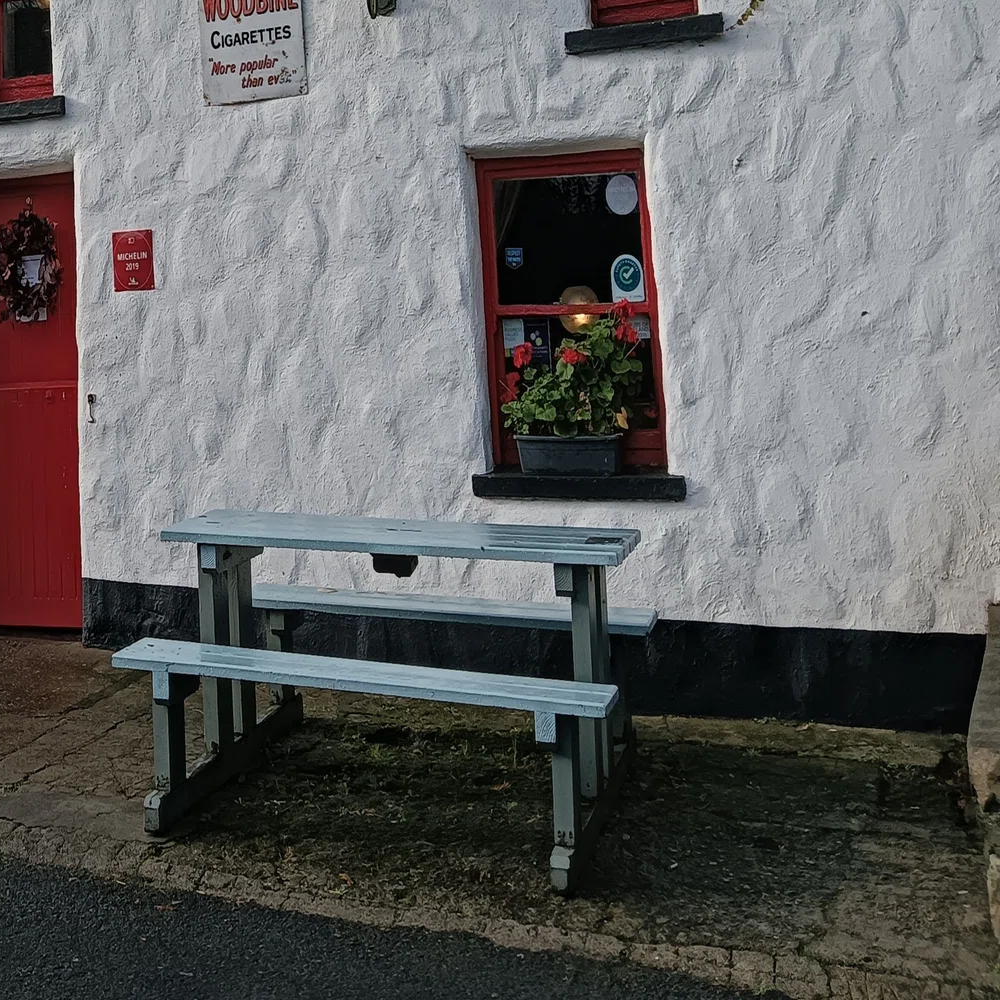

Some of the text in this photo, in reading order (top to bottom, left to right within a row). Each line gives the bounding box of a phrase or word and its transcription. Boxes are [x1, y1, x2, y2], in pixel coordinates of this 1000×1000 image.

[211, 25, 292, 49] CIGARETTES
[239, 55, 279, 75] popular
[241, 74, 264, 89] than
[117, 251, 148, 261] MICHELIN
[125, 262, 140, 271] 2019
